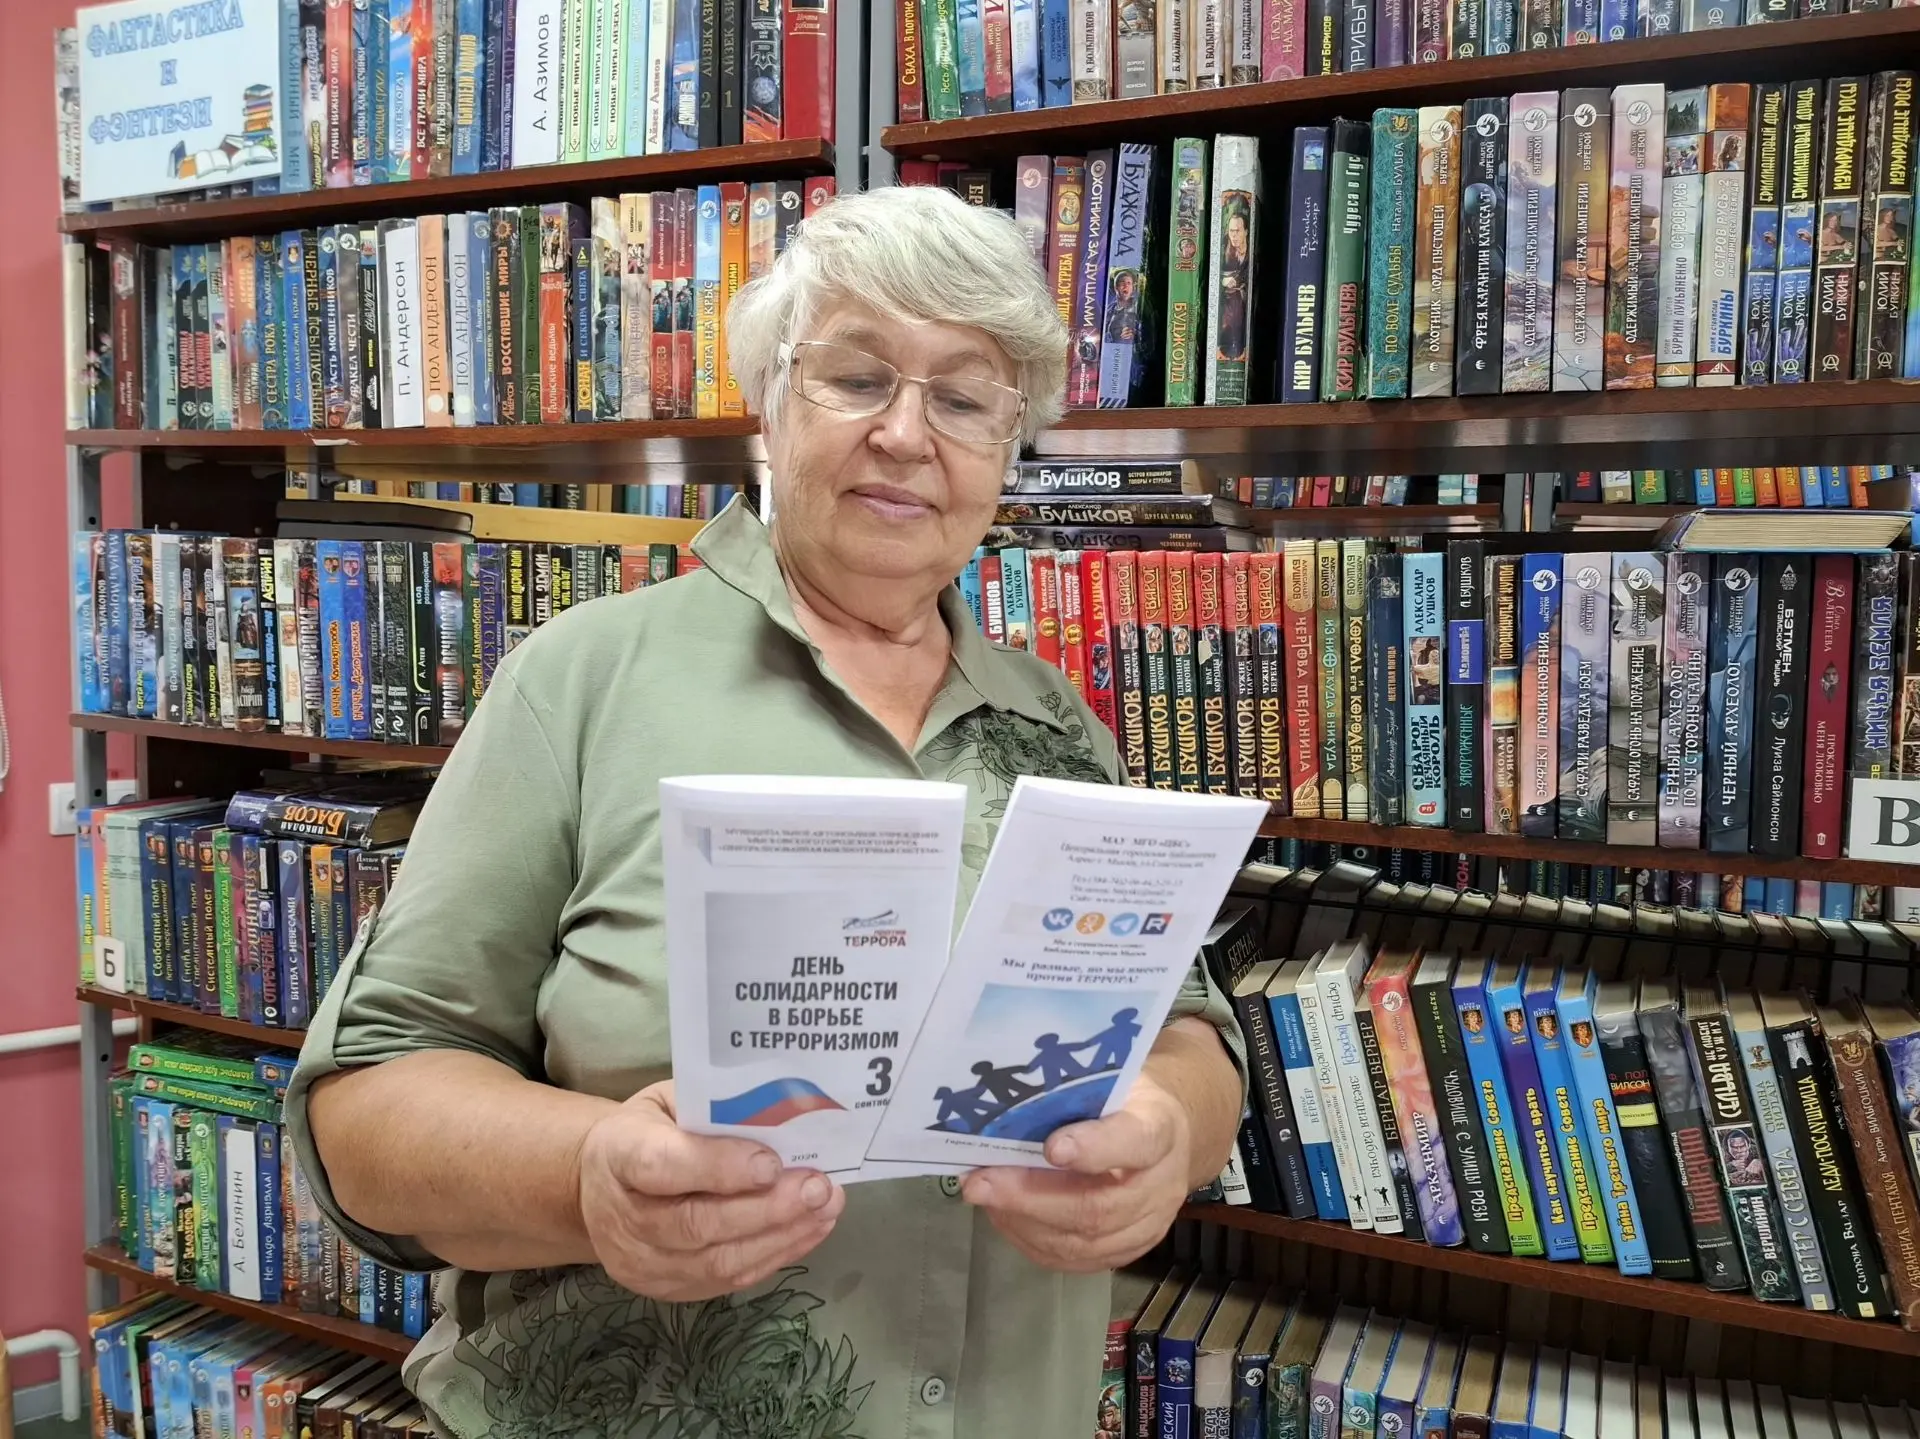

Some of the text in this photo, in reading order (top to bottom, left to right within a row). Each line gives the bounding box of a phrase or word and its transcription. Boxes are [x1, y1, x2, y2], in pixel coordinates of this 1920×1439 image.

[87, 3, 244, 57] ФАНТАСТИКА
[437, 35, 446, 62] МИРА
[1322, 15, 1332, 54] БОРИСОВ
[160, 58, 178, 86] И
[533, 14, 550, 131] А. АЗИМОВ
[724, 90, 733, 107] 1
[1841, 83, 1857, 114] РОСЫ
[88, 96, 213, 144] ФЭНТЕЗИ
[417, 56, 426, 148] ВСЕ ГРАНИ МИРА
[700, 91, 711, 108] 2
[437, 118, 446, 145] ИГРЫ
[1116, 162, 1145, 256] БУДЖОЛД
[1344, 193, 1361, 234] Чудеса
[1672, 183, 1688, 215] РУСЬ
[1083, 160, 1106, 328] ОХОТНИКИ ЗА ДУШАМИ
[306, 248, 318, 311] ЧЕРНЫЕ
[1385, 244, 1404, 353] ПО ВОЛЕ СУДЬБЫ
[1822, 275, 1834, 312] ЮЛИЙ
[1836, 275, 1848, 320] БУРКИН
[396, 261, 410, 396] П. Андерсон
[425, 256, 440, 391] ПОЛ АНДЕРСОН
[454, 254, 469, 386] ПОЛ АНДЕРСОН
[499, 247, 511, 376] ВОССТАВШИЕ МИРЫ
[1293, 284, 1316, 390] КИР БУЛЫЧЕВ
[1336, 283, 1358, 392] КИР БУЛЫЧЕВ
[1717, 289, 1733, 355] БУРКИНЫ
[265, 323, 276, 403] СЕСТРА РОКА
[1170, 302, 1186, 384] БУДЖОЛД
[1040, 469, 1121, 489] БУШКОВ
[1039, 506, 1134, 523] БУШКОВ
[1091, 560, 1103, 621] БУШКОВ
[1144, 567, 1161, 620] СВАРОГ
[1171, 568, 1189, 622] СВАРОГ
[1201, 566, 1218, 620] СВАРОГ
[1259, 565, 1275, 620] СВАРОГ
[1414, 567, 1424, 634] АЛЕКСАНДР
[1460, 556, 1472, 594] БУШКОВ
[986, 581, 1003, 635] БУШКОВ
[1499, 564, 1514, 659] ОПРОКИНУТЫЙ КУПОЛ
[1582, 661, 1592, 690] БОЕМ
[1631, 646, 1645, 720] НА ПОРАЖЕНИЕ
[1124, 691, 1145, 767] БУШКОВ
[1149, 695, 1170, 772] БУШКОВ
[1176, 697, 1197, 775] БУШКОВ
[1205, 697, 1226, 775] БУШКОВ
[1237, 700, 1256, 778] БУШКОВ
[1260, 698, 1281, 778] БУШКОВ
[1537, 631, 1549, 797] ЭФФЕКТ ПРОНИКНОВЕНИЯ
[1666, 662, 1684, 806] ЧЕРНЫЙ АРХЕОЛОГ
[1723, 659, 1741, 806] ЧЕРНЫЙ АРХЕОЛОГ
[1324, 722, 1336, 771] НИКУДА
[1412, 716, 1425, 791] СВАРОГ
[1460, 704, 1473, 787] ЗАВОРОЖЕННЫЕ
[1684, 702, 1699, 806] ПО ТУ СТОРОНУ
[1770, 736, 1785, 842] Луиза Саймонсон
[284, 805, 345, 835] БАСОВ
[206, 889, 214, 921] полет
[288, 897, 296, 952] НЕБЕСАМИ
[103, 948, 115, 977] Б
[791, 957, 845, 977] ДЕНЬ
[844, 936, 906, 947] ТЕРРОРА
[1002, 958, 1025, 969] Мы
[735, 982, 898, 1003] СОЛИДАРНОСТИ
[1026, 973, 1140, 984] против ТЕРРОРА!
[731, 1031, 898, 1050] С ТЕРРОРИЗМОМ
[769, 1008, 863, 1026] В БОРЬБЕ
[866, 1057, 893, 1096] 3
[1249, 1004, 1286, 1120] БЕРНАР ВЕРБЕР
[1360, 1022, 1398, 1140] БЕРНАР ВЕРБЕР
[1611, 1080, 1651, 1092] ВИЛСОН
[1361, 1130, 1381, 1178] бабочка
[1456, 1132, 1470, 1142] С
[1481, 1081, 1523, 1221] Предсказание Совета
[1525, 1088, 1565, 1224] Как научиться врать
[1556, 1086, 1596, 1230] Предсказание Совета
[1459, 1145, 1481, 1184] УЛИЦЫ
[1592, 1097, 1637, 1241] Тайна Третьего мира
[1772, 1149, 1805, 1212] СЕВЕРА
[232, 1171, 245, 1273] А. Белянин
[1469, 1188, 1489, 1222] РОЗЫ
[1740, 1197, 1753, 1224] ЛЕВ
[1881, 1171, 1904, 1225] ПЕНТАКЛЯ
[265, 1234, 274, 1263] надо
[1751, 1195, 1777, 1260] ВЕРШИНИН
[264, 1266, 273, 1281] Не
[1791, 1237, 1817, 1284] ВЕТЕР
